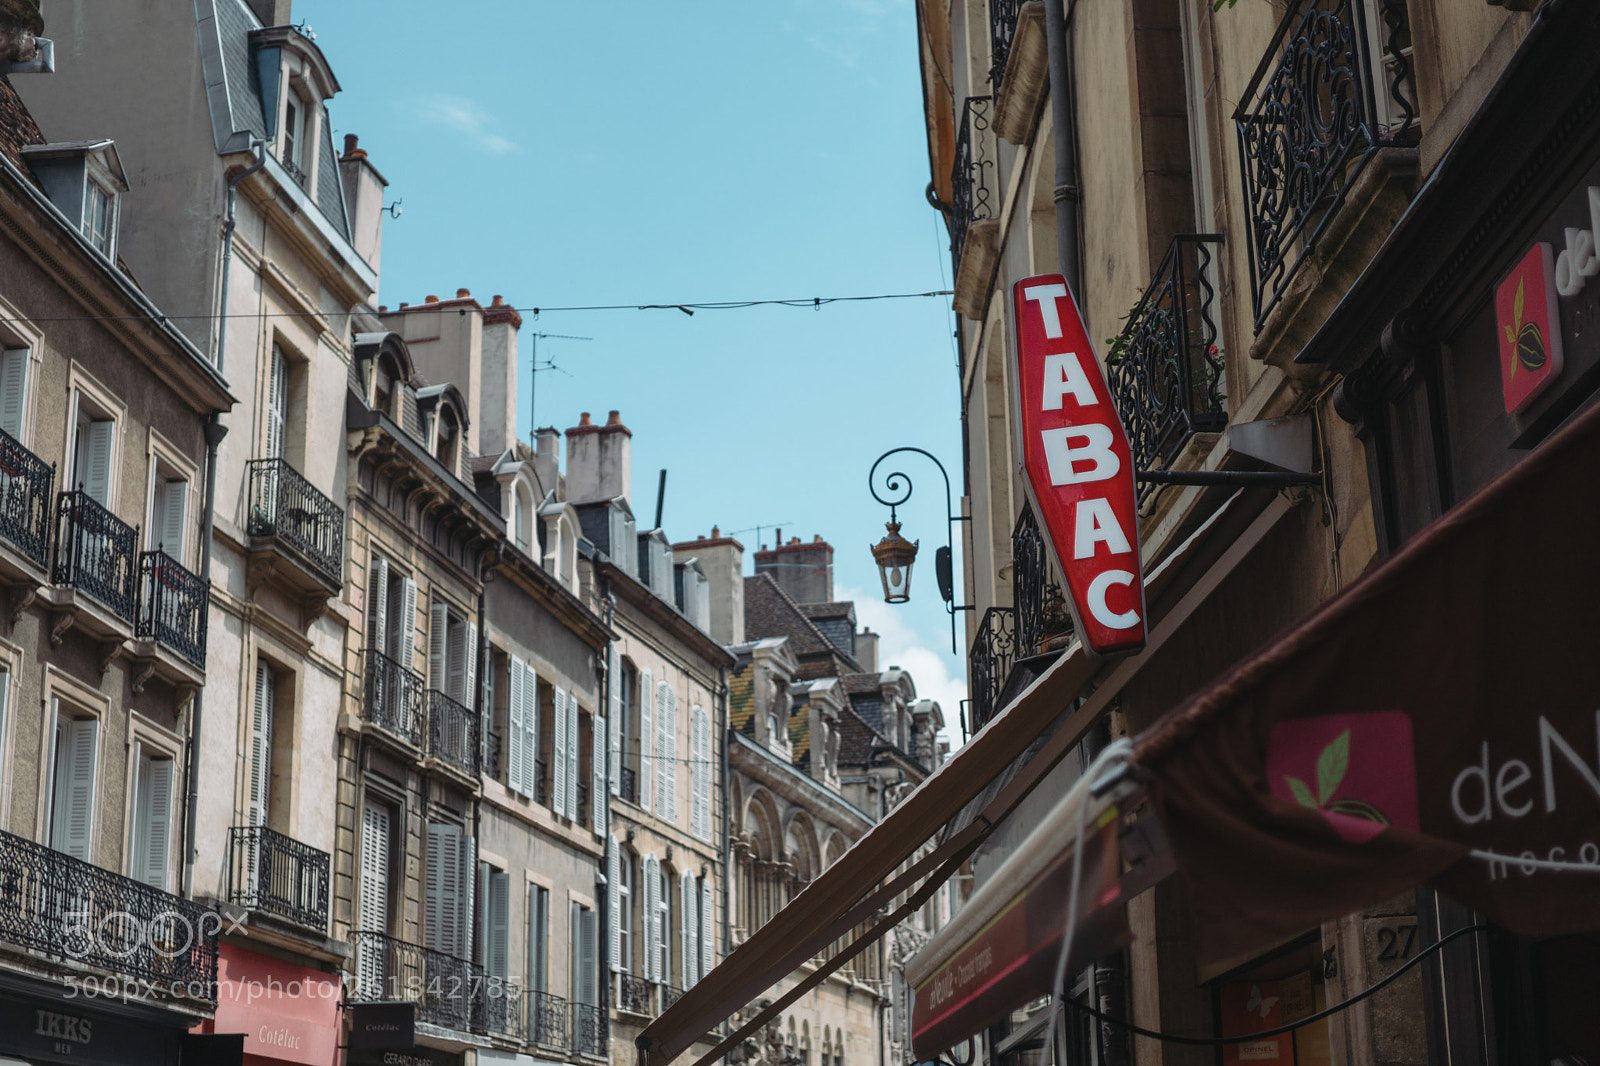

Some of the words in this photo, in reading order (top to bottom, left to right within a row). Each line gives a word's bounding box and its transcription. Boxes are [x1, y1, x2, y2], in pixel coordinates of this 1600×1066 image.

[1555, 185, 1600, 297] de
[1024, 283, 1141, 630] TABAC
[1377, 925, 1418, 962] 27
[34, 1009, 92, 1045] IKKS
[258, 1024, 301, 1050] Cotélac
[54, 1041, 72, 1055] MEN
